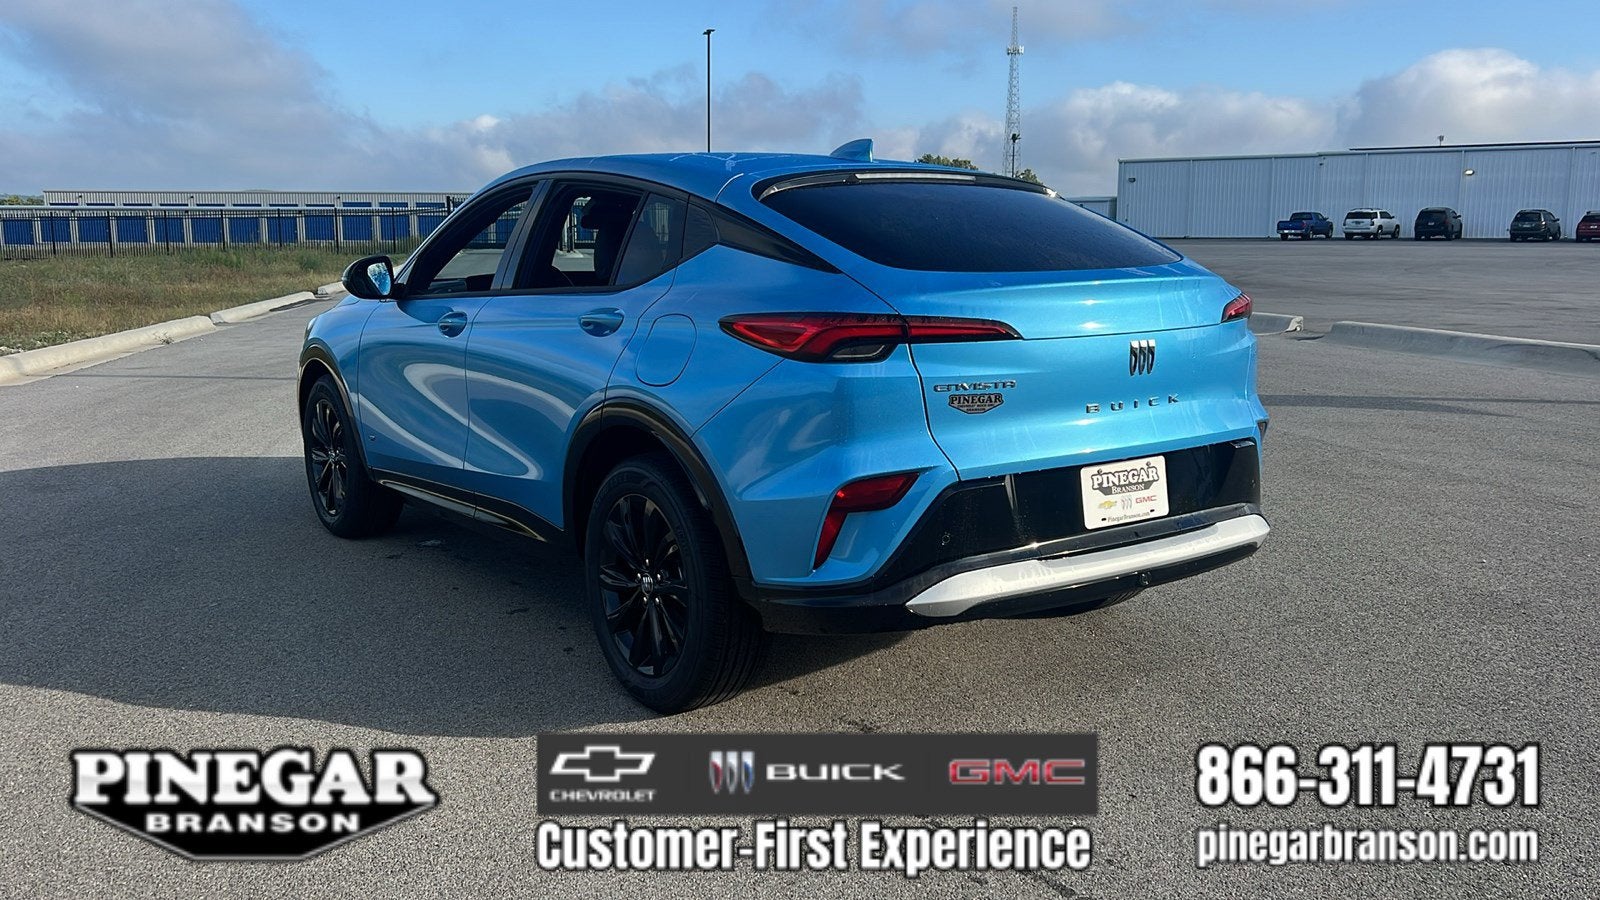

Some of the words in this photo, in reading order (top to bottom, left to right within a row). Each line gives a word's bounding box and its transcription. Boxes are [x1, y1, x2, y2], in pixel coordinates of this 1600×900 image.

[950, 395, 1002, 404] PINEGAR
[1086, 394, 1179, 413] BUICK
[1092, 467, 1159, 489] PINEGAR
[1111, 483, 1145, 495] BRANSON
[1135, 494, 1157, 504] GMC
